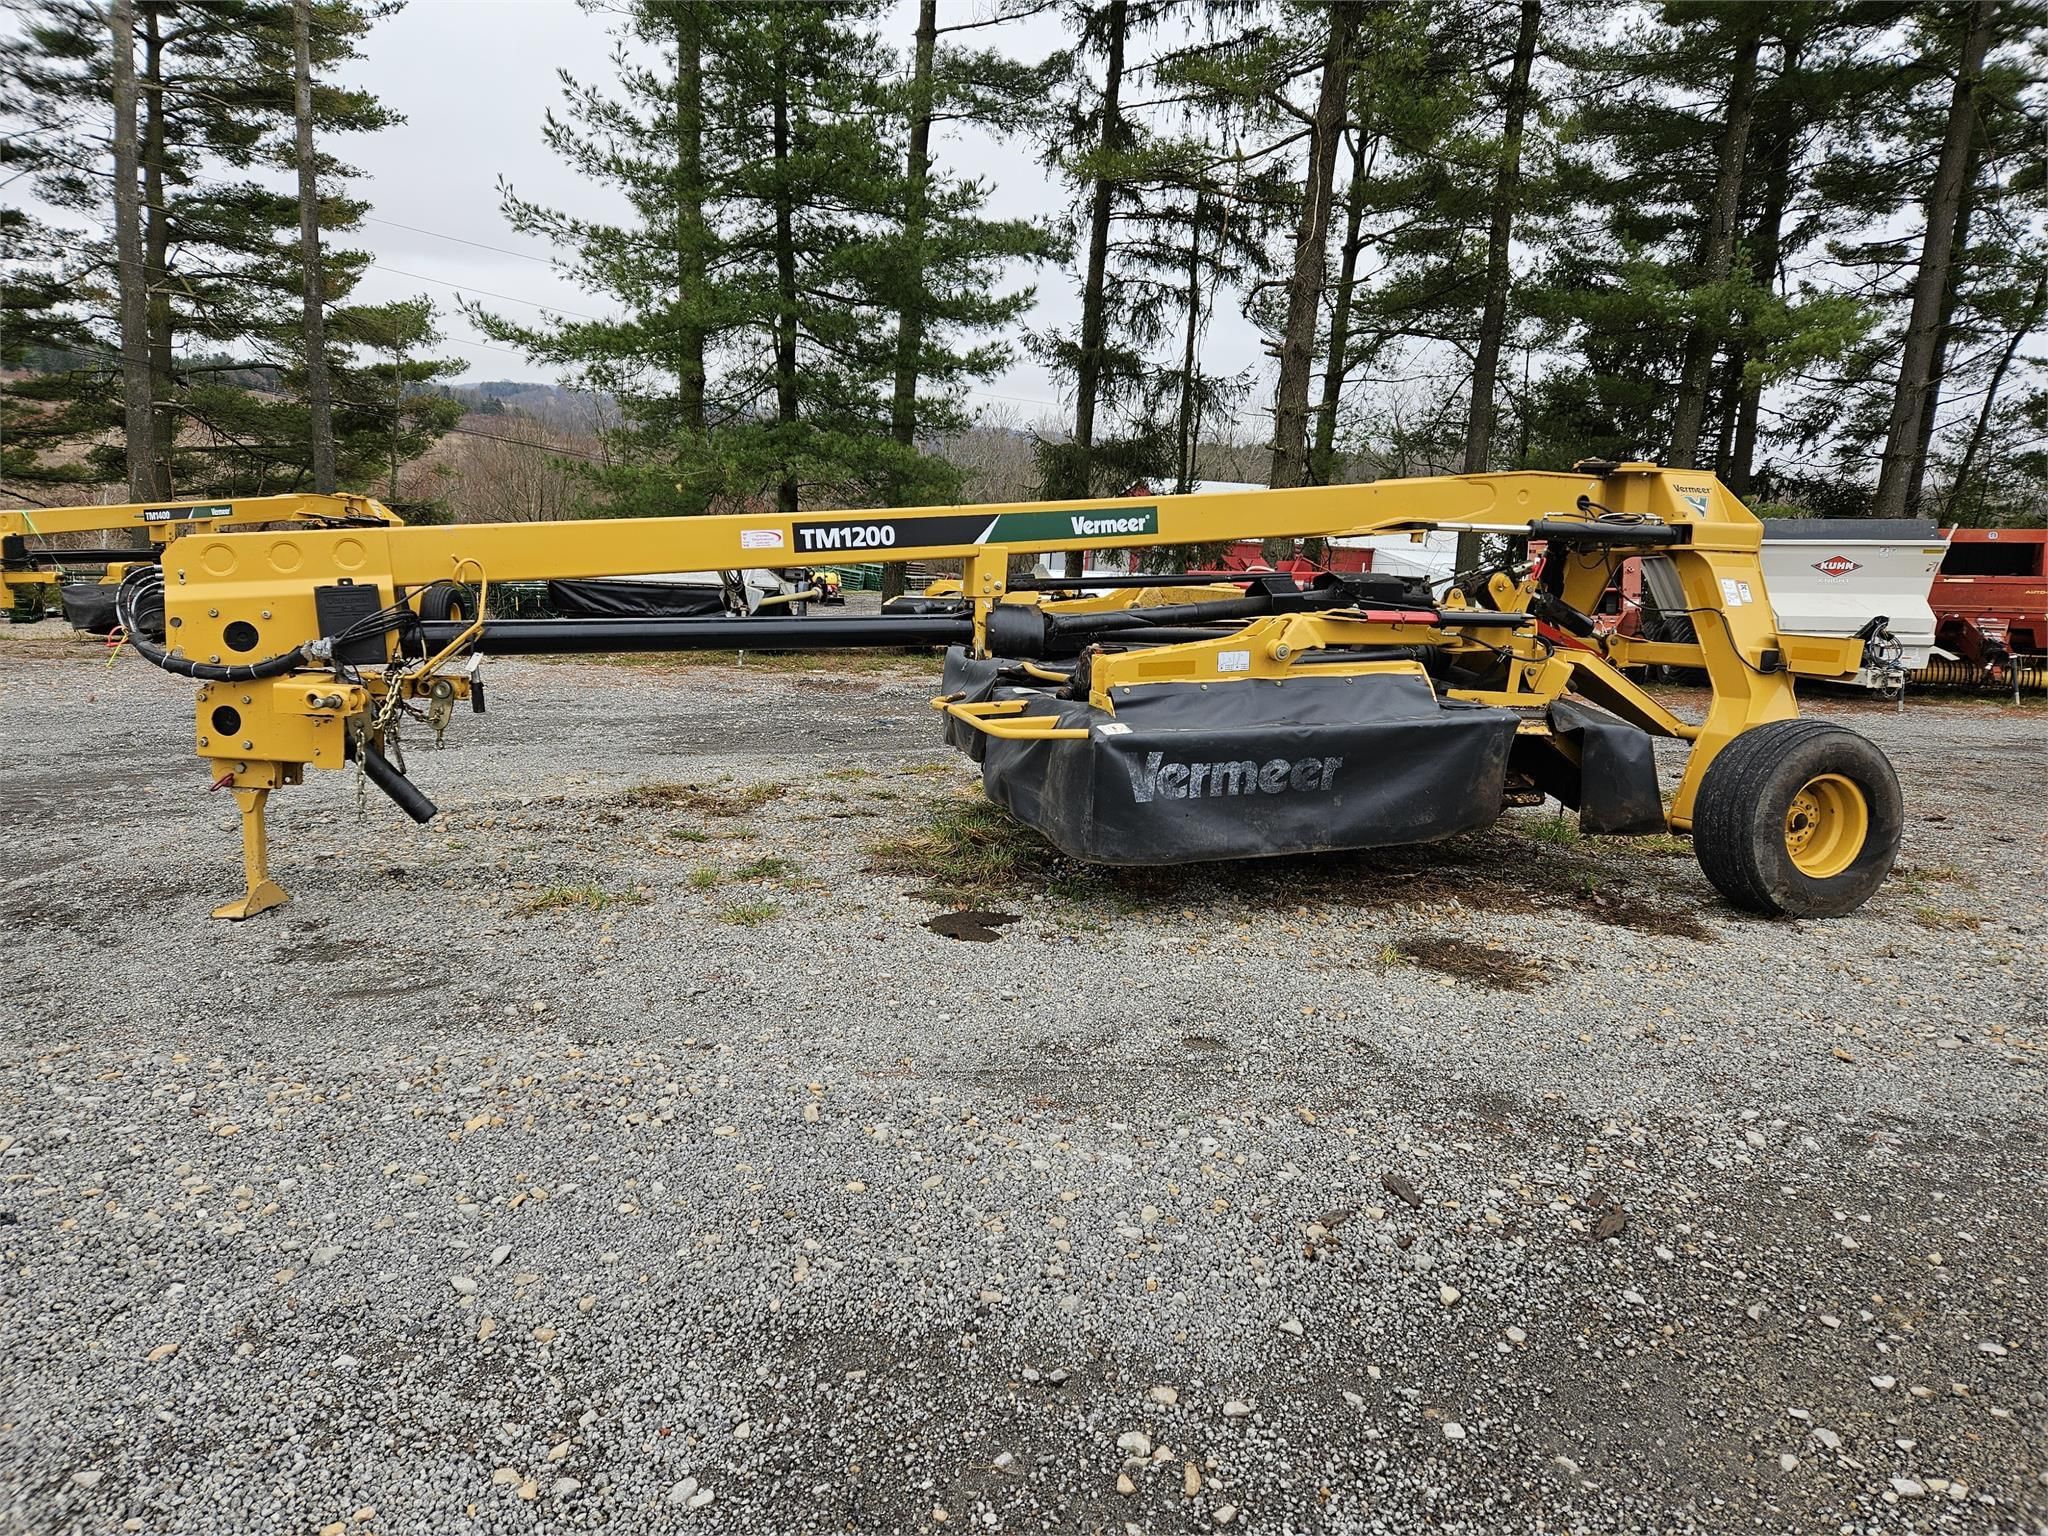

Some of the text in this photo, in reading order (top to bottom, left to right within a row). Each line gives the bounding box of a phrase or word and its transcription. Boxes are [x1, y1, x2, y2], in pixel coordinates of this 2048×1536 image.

[1673, 484, 1712, 494] Vermeer
[145, 511, 170, 520] TM1400
[799, 525, 895, 549] TM1200
[1820, 561, 1854, 570] KUHN
[1122, 751, 1344, 803] Vermeer
